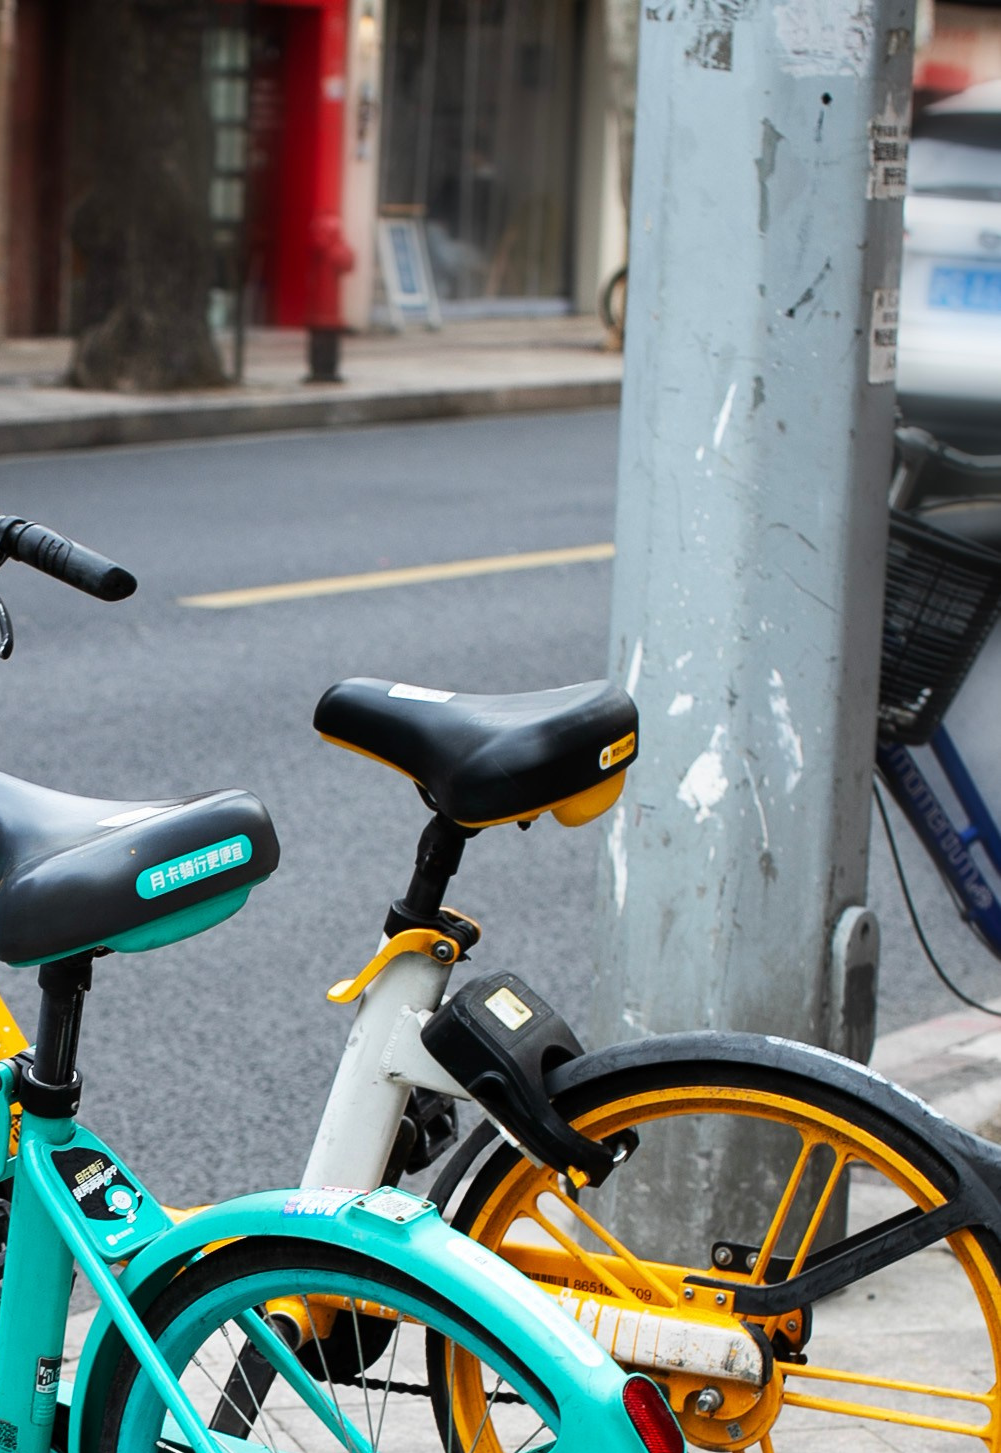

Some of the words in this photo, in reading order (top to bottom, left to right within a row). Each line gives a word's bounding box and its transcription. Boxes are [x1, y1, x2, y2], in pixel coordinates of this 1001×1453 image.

[149, 842, 244, 891] 月卡骑行更便宜
